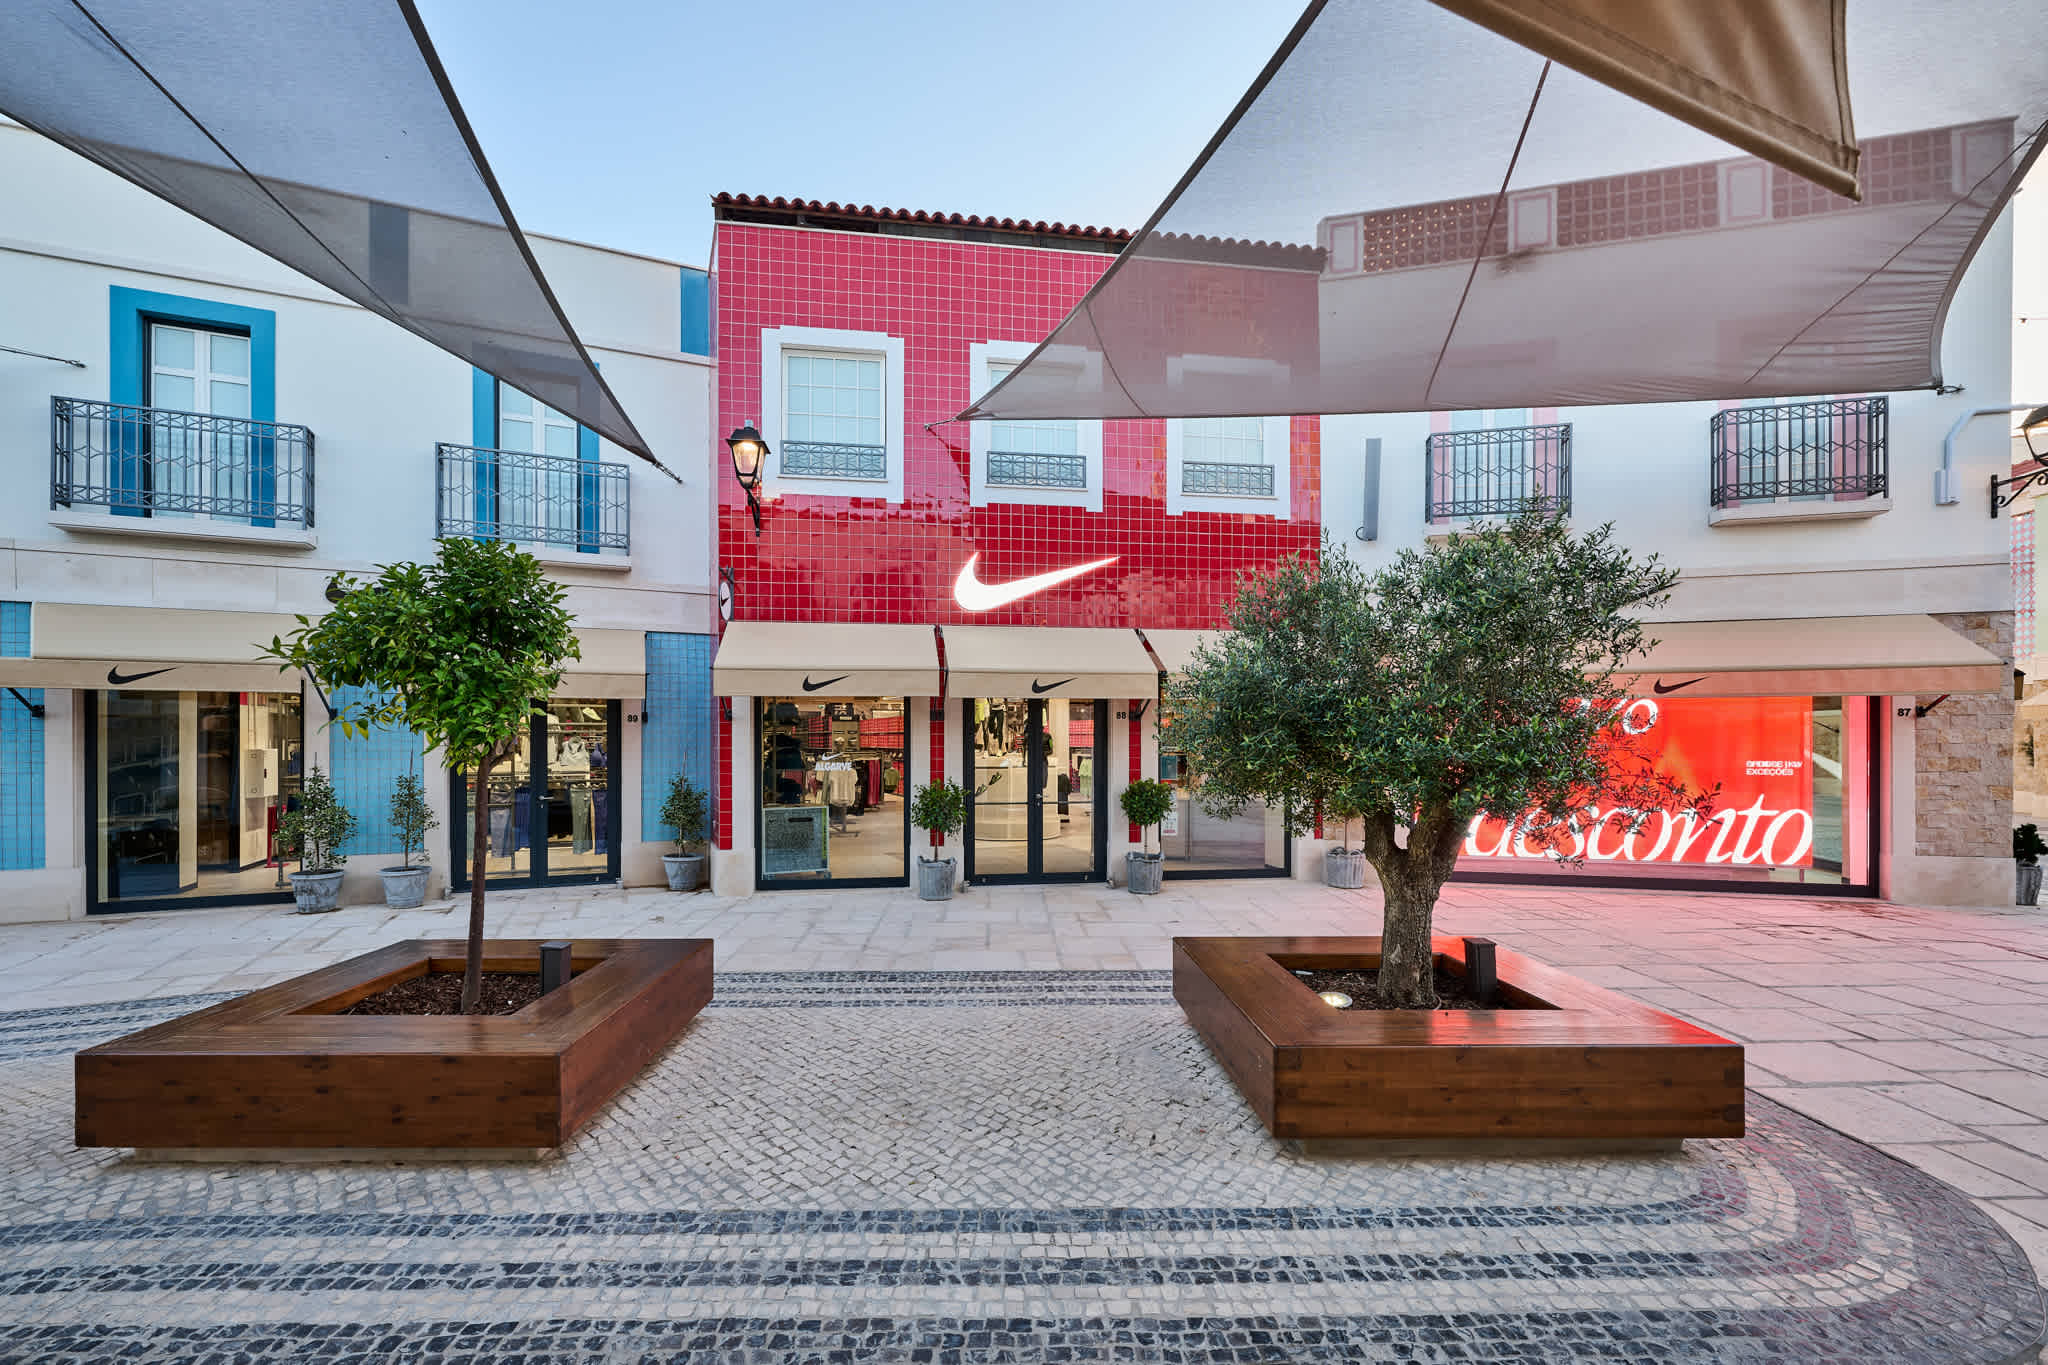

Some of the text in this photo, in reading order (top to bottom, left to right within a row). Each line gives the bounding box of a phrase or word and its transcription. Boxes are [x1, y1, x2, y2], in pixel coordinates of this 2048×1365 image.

[1116, 711, 1127, 720] 88
[1897, 707, 1912, 717] 87
[627, 714, 639, 723] 89
[815, 761, 853, 771] ALGARVE
